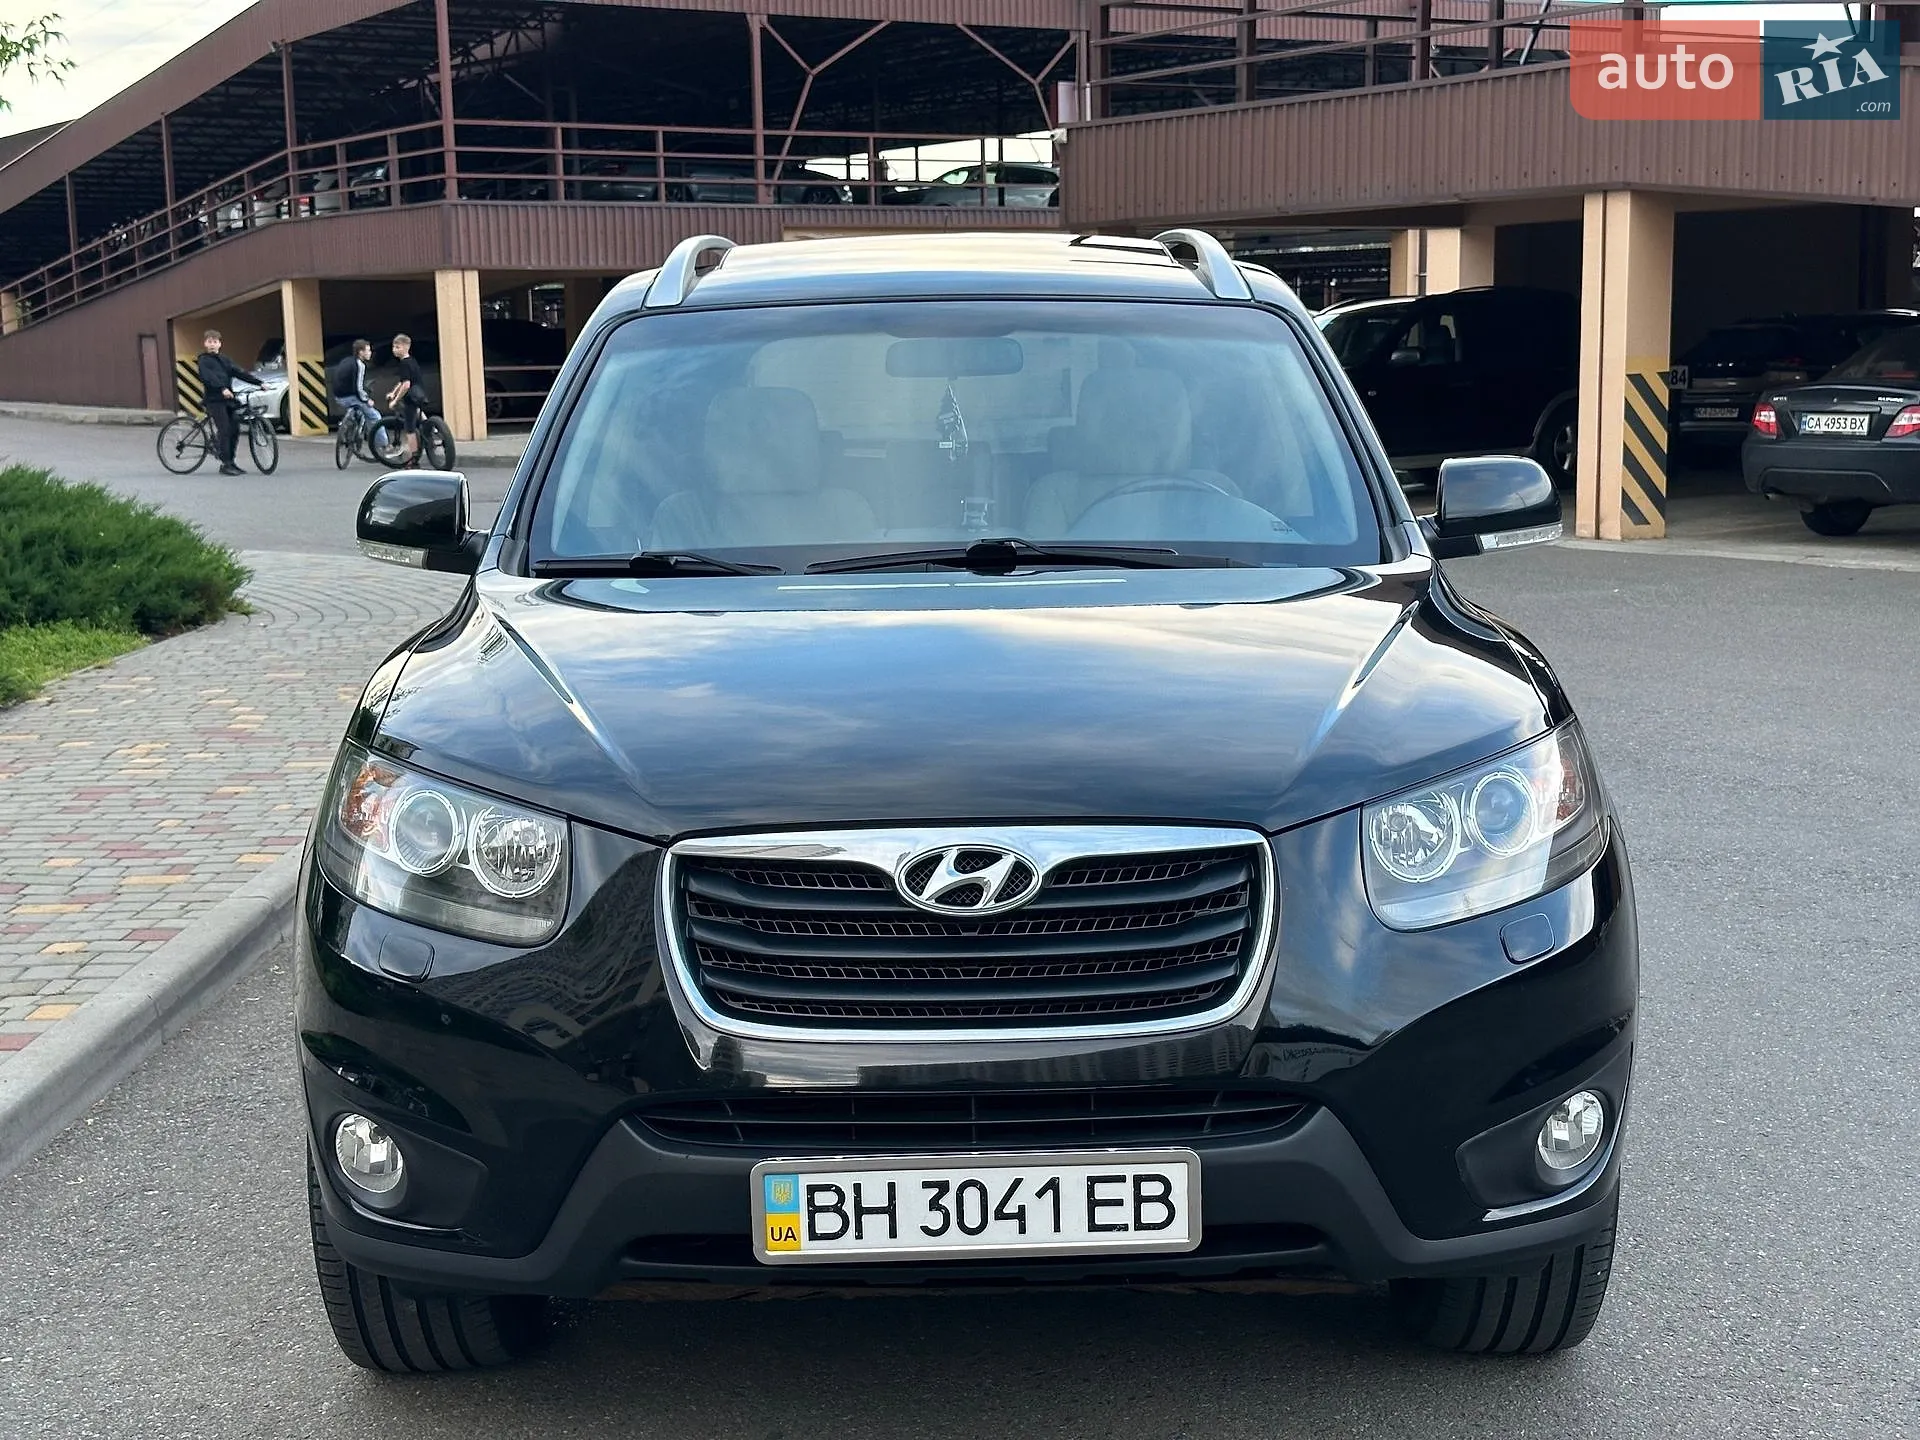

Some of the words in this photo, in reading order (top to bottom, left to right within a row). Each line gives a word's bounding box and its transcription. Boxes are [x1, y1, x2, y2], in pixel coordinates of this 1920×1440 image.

[1671, 370, 1687, 386] 84
[1807, 417, 1820, 430] CA
[1824, 417, 1847, 430] 4953
[1850, 417, 1865, 430] BX
[805, 1182, 897, 1241] BH
[919, 1177, 1061, 1237] 3041
[1086, 1174, 1175, 1232] EB
[770, 1227, 797, 1242] UA
